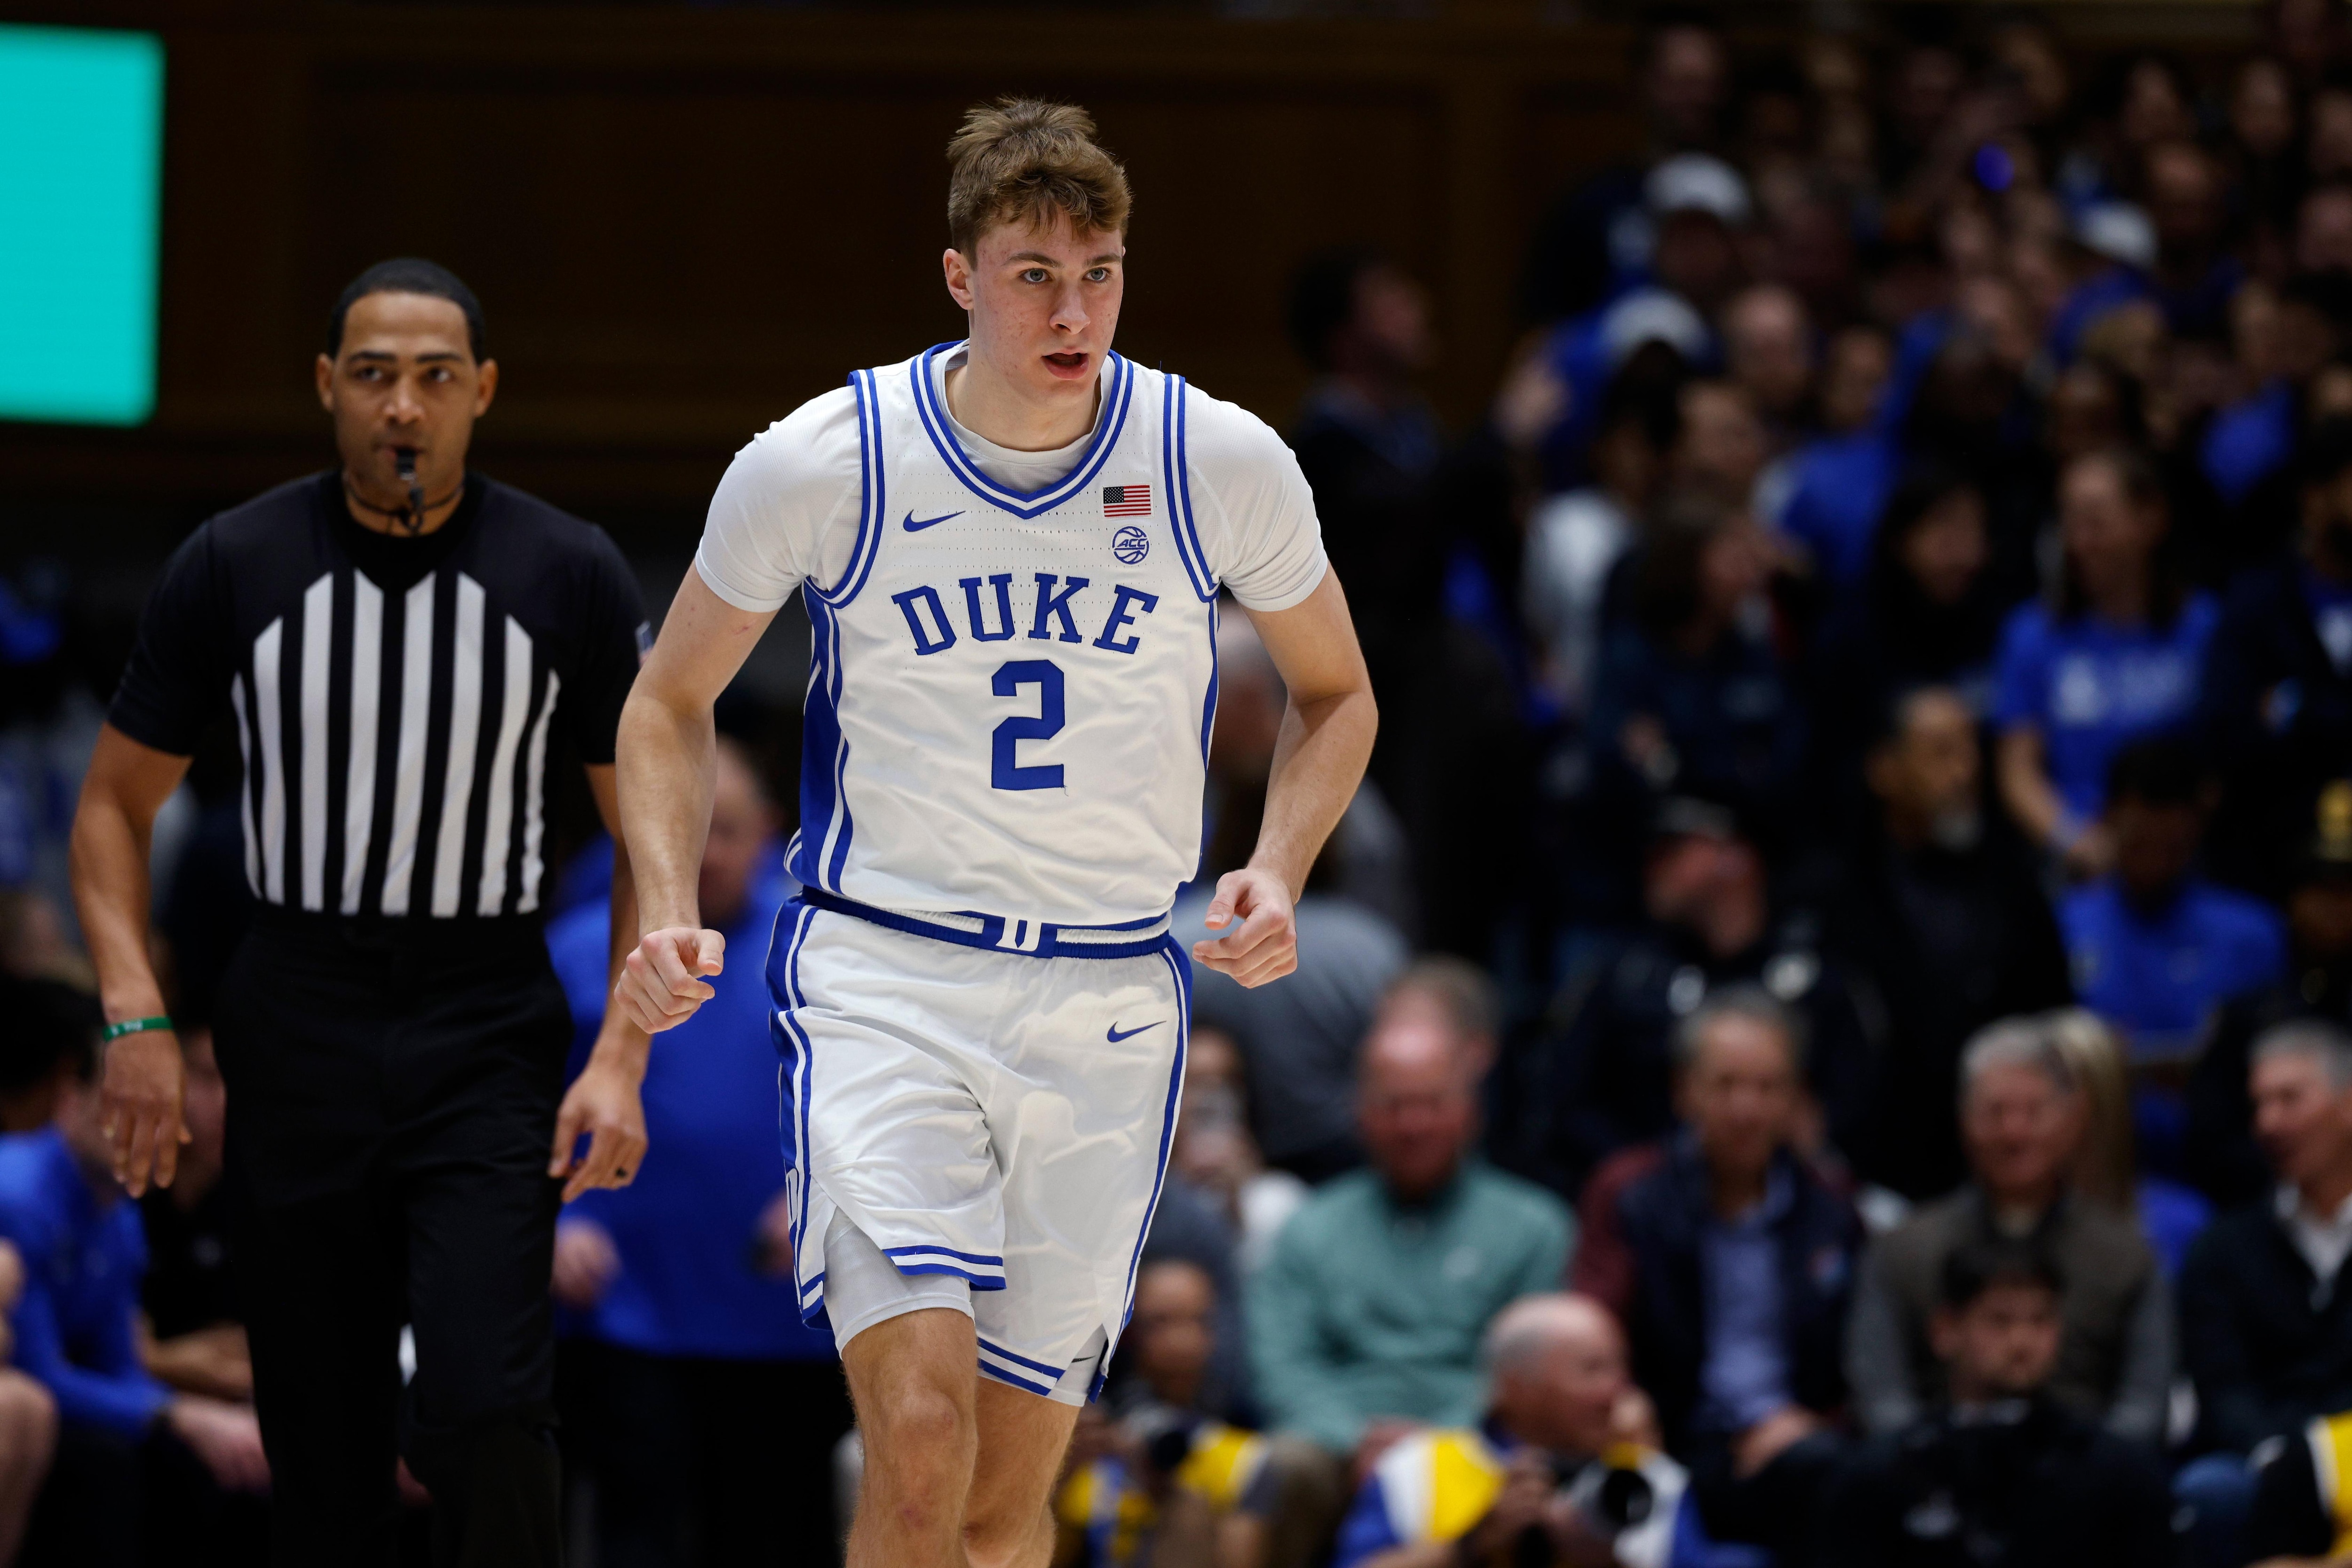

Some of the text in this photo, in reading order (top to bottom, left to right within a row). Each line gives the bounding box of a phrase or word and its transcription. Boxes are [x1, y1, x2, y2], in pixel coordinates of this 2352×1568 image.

[1117, 538, 1147, 548] ACC
[891, 573, 1159, 656] DUKE
[992, 659, 1065, 791] 2
